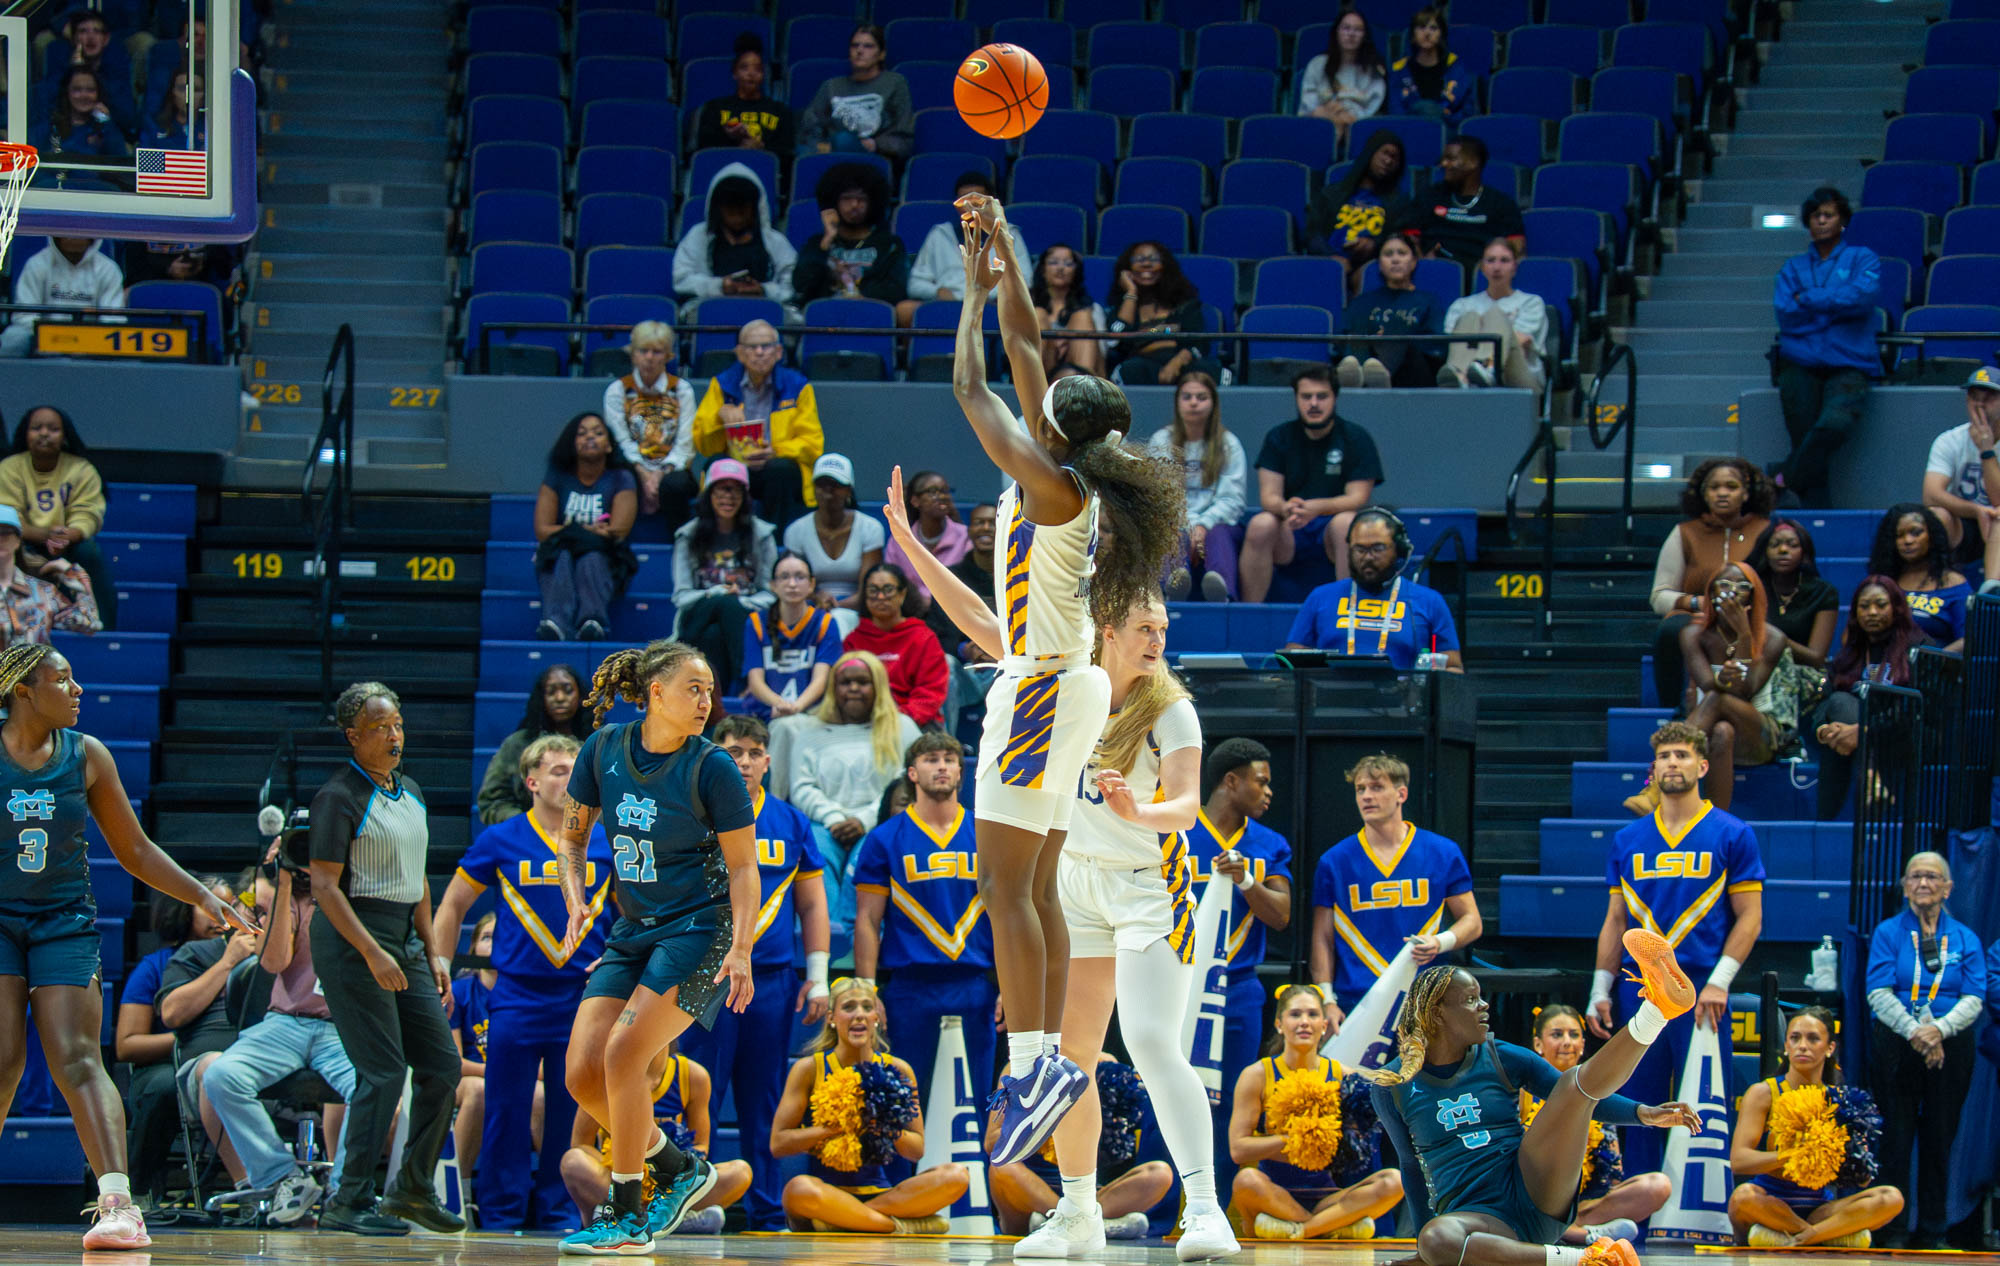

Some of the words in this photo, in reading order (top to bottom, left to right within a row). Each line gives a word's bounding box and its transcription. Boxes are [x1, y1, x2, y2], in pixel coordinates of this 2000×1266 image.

[104, 331, 173, 352] 119
[250, 384, 301, 403] 226
[389, 388, 441, 407] 227
[233, 553, 283, 578] 119
[406, 557, 456, 581] 120
[1495, 574, 1544, 598] 120
[1337, 597, 1406, 620] LSU
[762, 645, 817, 674] LSU
[17, 827, 48, 873] 3
[613, 834, 658, 883] 21
[902, 851, 978, 884] LSU
[1189, 855, 1266, 884] LU
[1632, 851, 1713, 881] LSU
[1348, 877, 1430, 913] LSU
